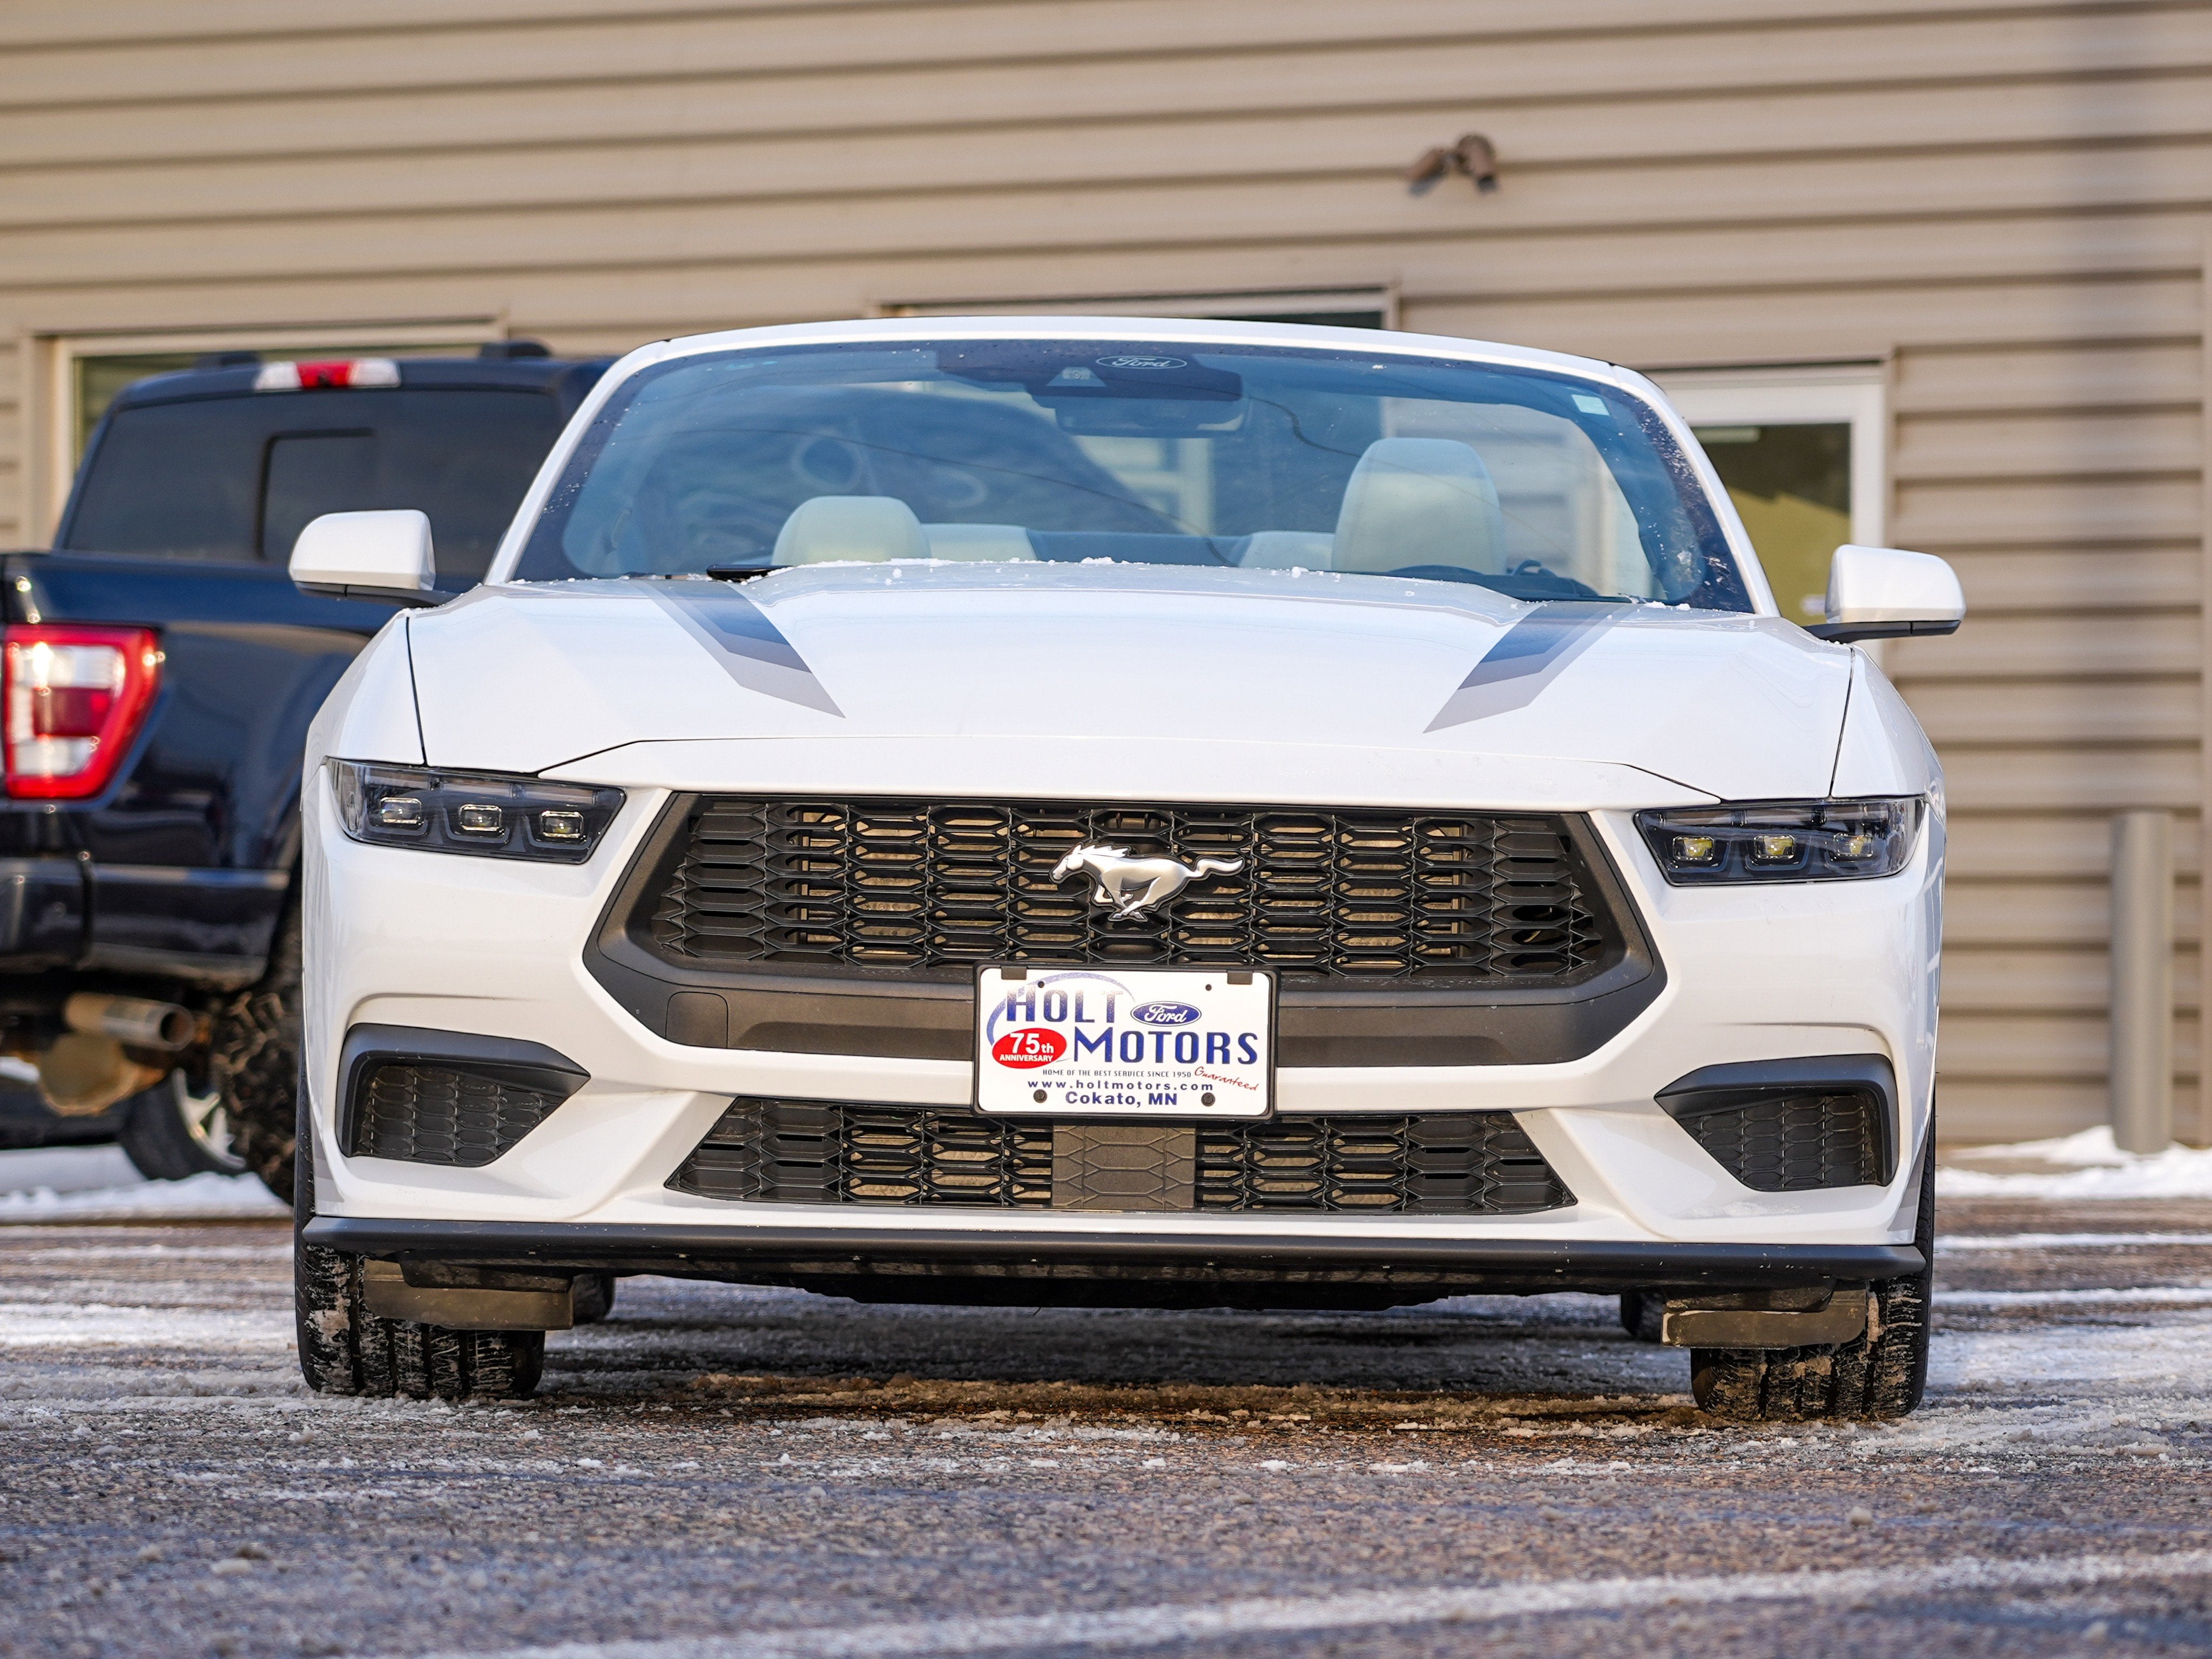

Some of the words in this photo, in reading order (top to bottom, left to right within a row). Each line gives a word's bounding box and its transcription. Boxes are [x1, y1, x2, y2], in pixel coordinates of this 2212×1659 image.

[1112, 358, 1171, 367] Ford
[1007, 985, 1123, 1023] HOLT
[1144, 1004, 1188, 1023] Ford
[1009, 1033, 1055, 1054] 75th
[1074, 1026, 1258, 1065] MOTORS
[999, 1054, 1054, 1062] ANNIVERSARY
[1028, 1080, 1213, 1091] www.holtmotors.com
[1195, 1066, 1259, 1091] Guaranteed
[1065, 1091, 1141, 1107] Cokato,
[1148, 1092, 1177, 1105] MN
